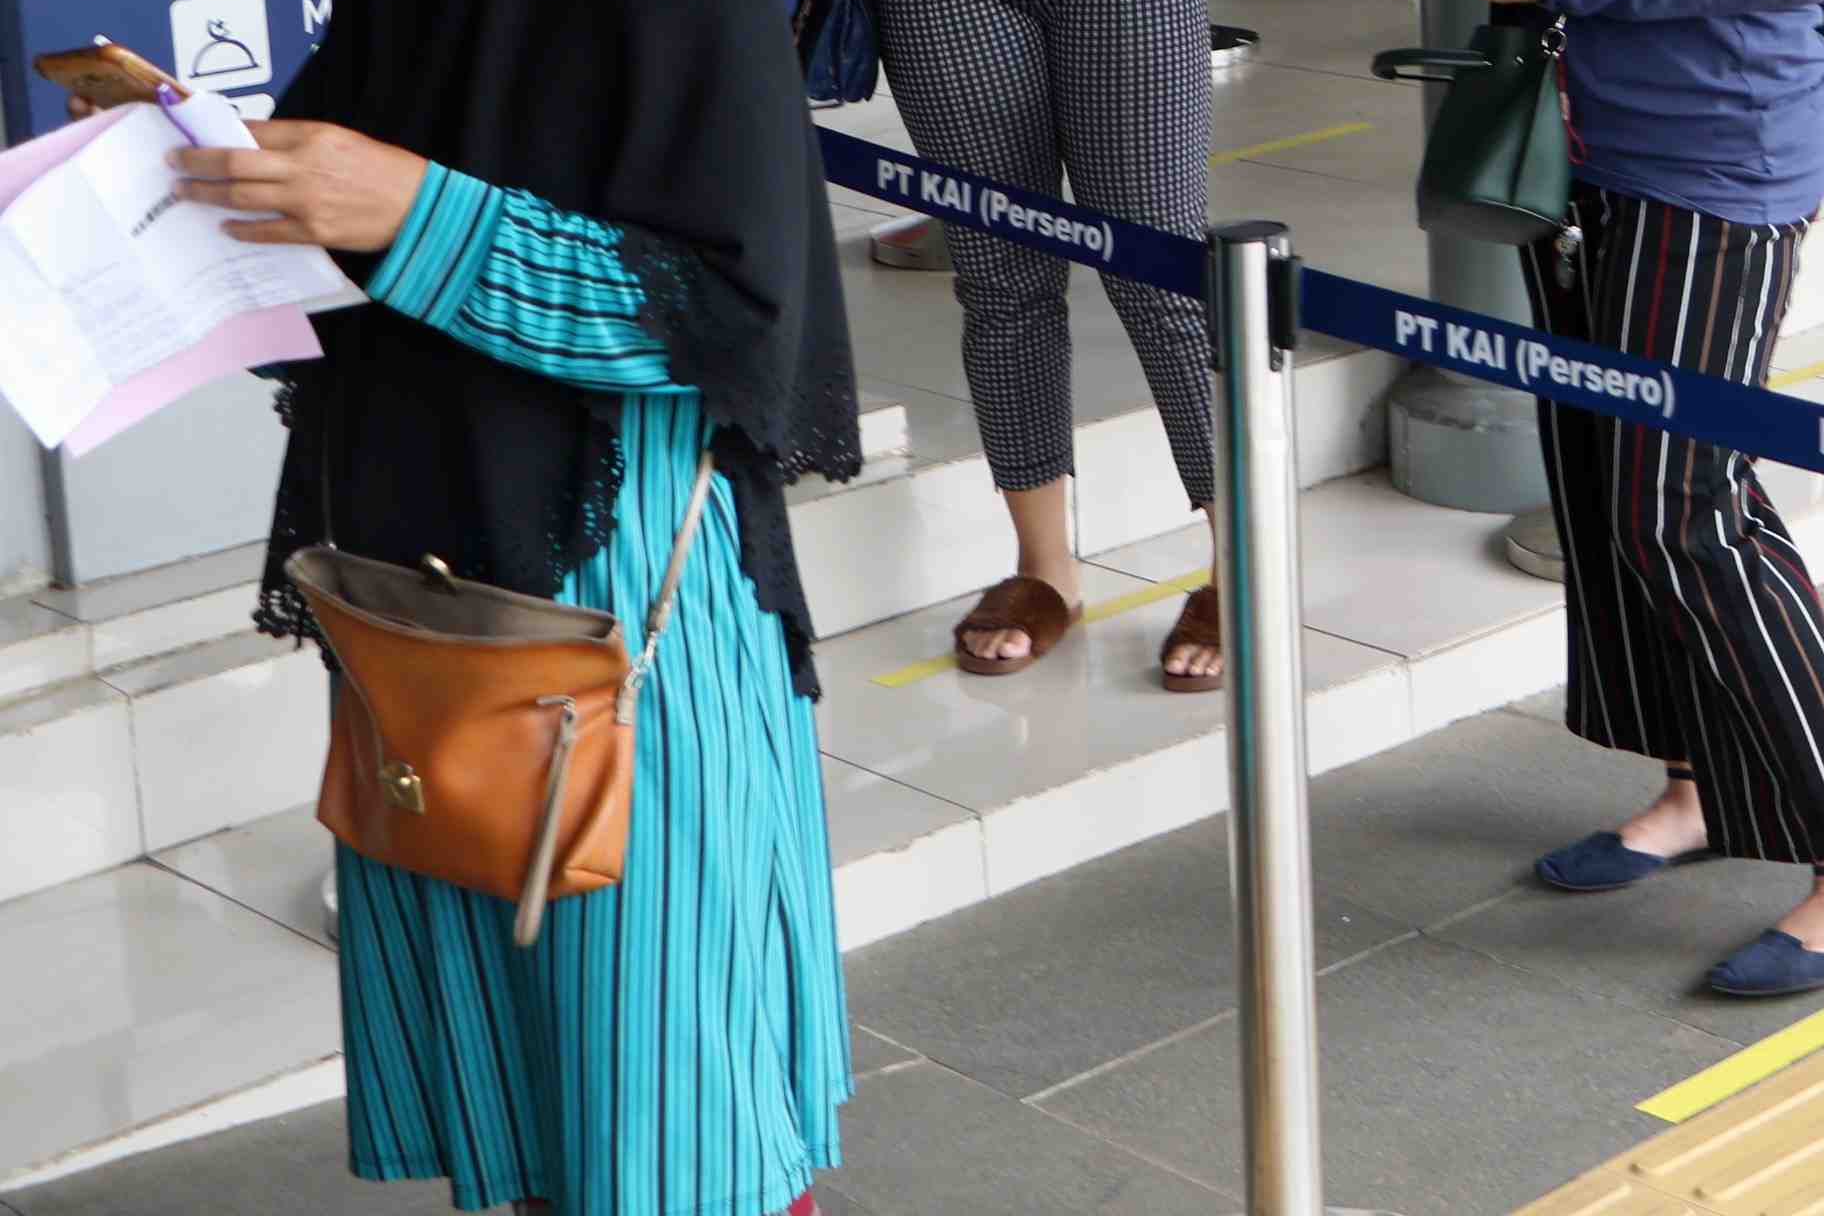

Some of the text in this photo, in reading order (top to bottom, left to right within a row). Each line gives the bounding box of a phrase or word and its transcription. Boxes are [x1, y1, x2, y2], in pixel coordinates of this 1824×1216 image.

[876, 158, 1115, 262] PT KAI (Persero)
[1395, 309, 1676, 419] PT KAI (Persero)
